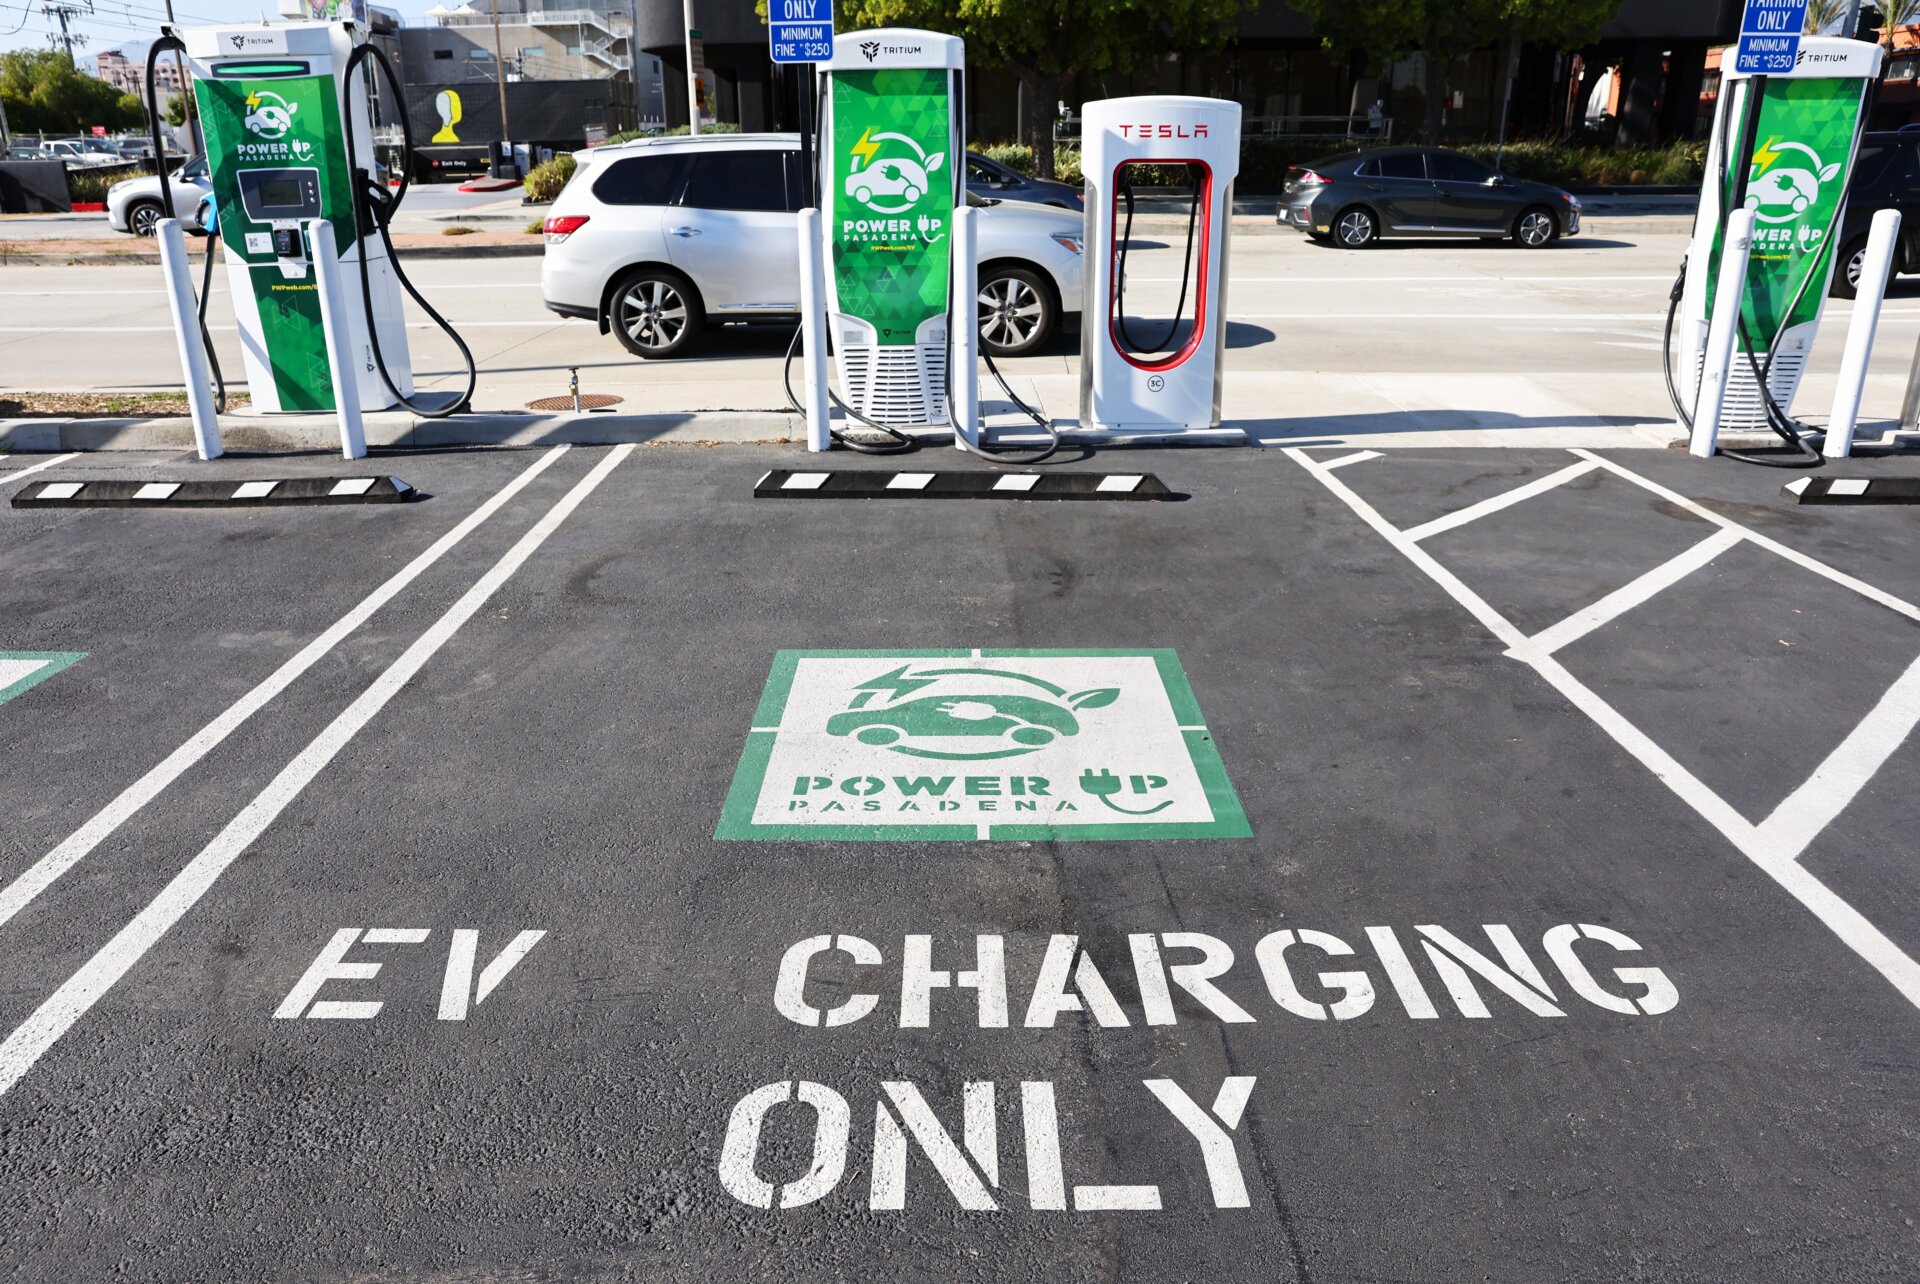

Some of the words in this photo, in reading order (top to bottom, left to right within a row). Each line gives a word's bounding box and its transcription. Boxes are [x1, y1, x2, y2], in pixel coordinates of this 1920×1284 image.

[784, 0, 817, 19] ONLY
[1757, 10, 1791, 30] ONLY
[781, 27, 823, 41] MINIMUM
[775, 43, 796, 57] FINE
[804, 42, 830, 58] $250
[883, 46, 922, 54] TRITIUM
[1748, 38, 1790, 52] MINIMUM
[1739, 54, 1760, 68] FINE
[1767, 54, 1793, 69] $250
[1808, 54, 1848, 62] TRITIUM
[1119, 124, 1208, 138] TESLA
[237, 143, 289, 154] POWER
[292, 138, 313, 160] UP
[843, 219, 912, 233] POWER
[917, 215, 944, 241] UP
[843, 233, 918, 241] PASADENA
[1751, 228, 1793, 241] WER
[1797, 225, 1823, 251] UP
[1750, 242, 1796, 250] ADENA
[792, 775, 1052, 797] POWER
[1078, 768, 1173, 814] UP
[788, 800, 1079, 812] PASADENA
[273, 928, 549, 1020] EV
[773, 923, 1680, 1028] CHARGING
[718, 1076, 1257, 1211] ONLY
